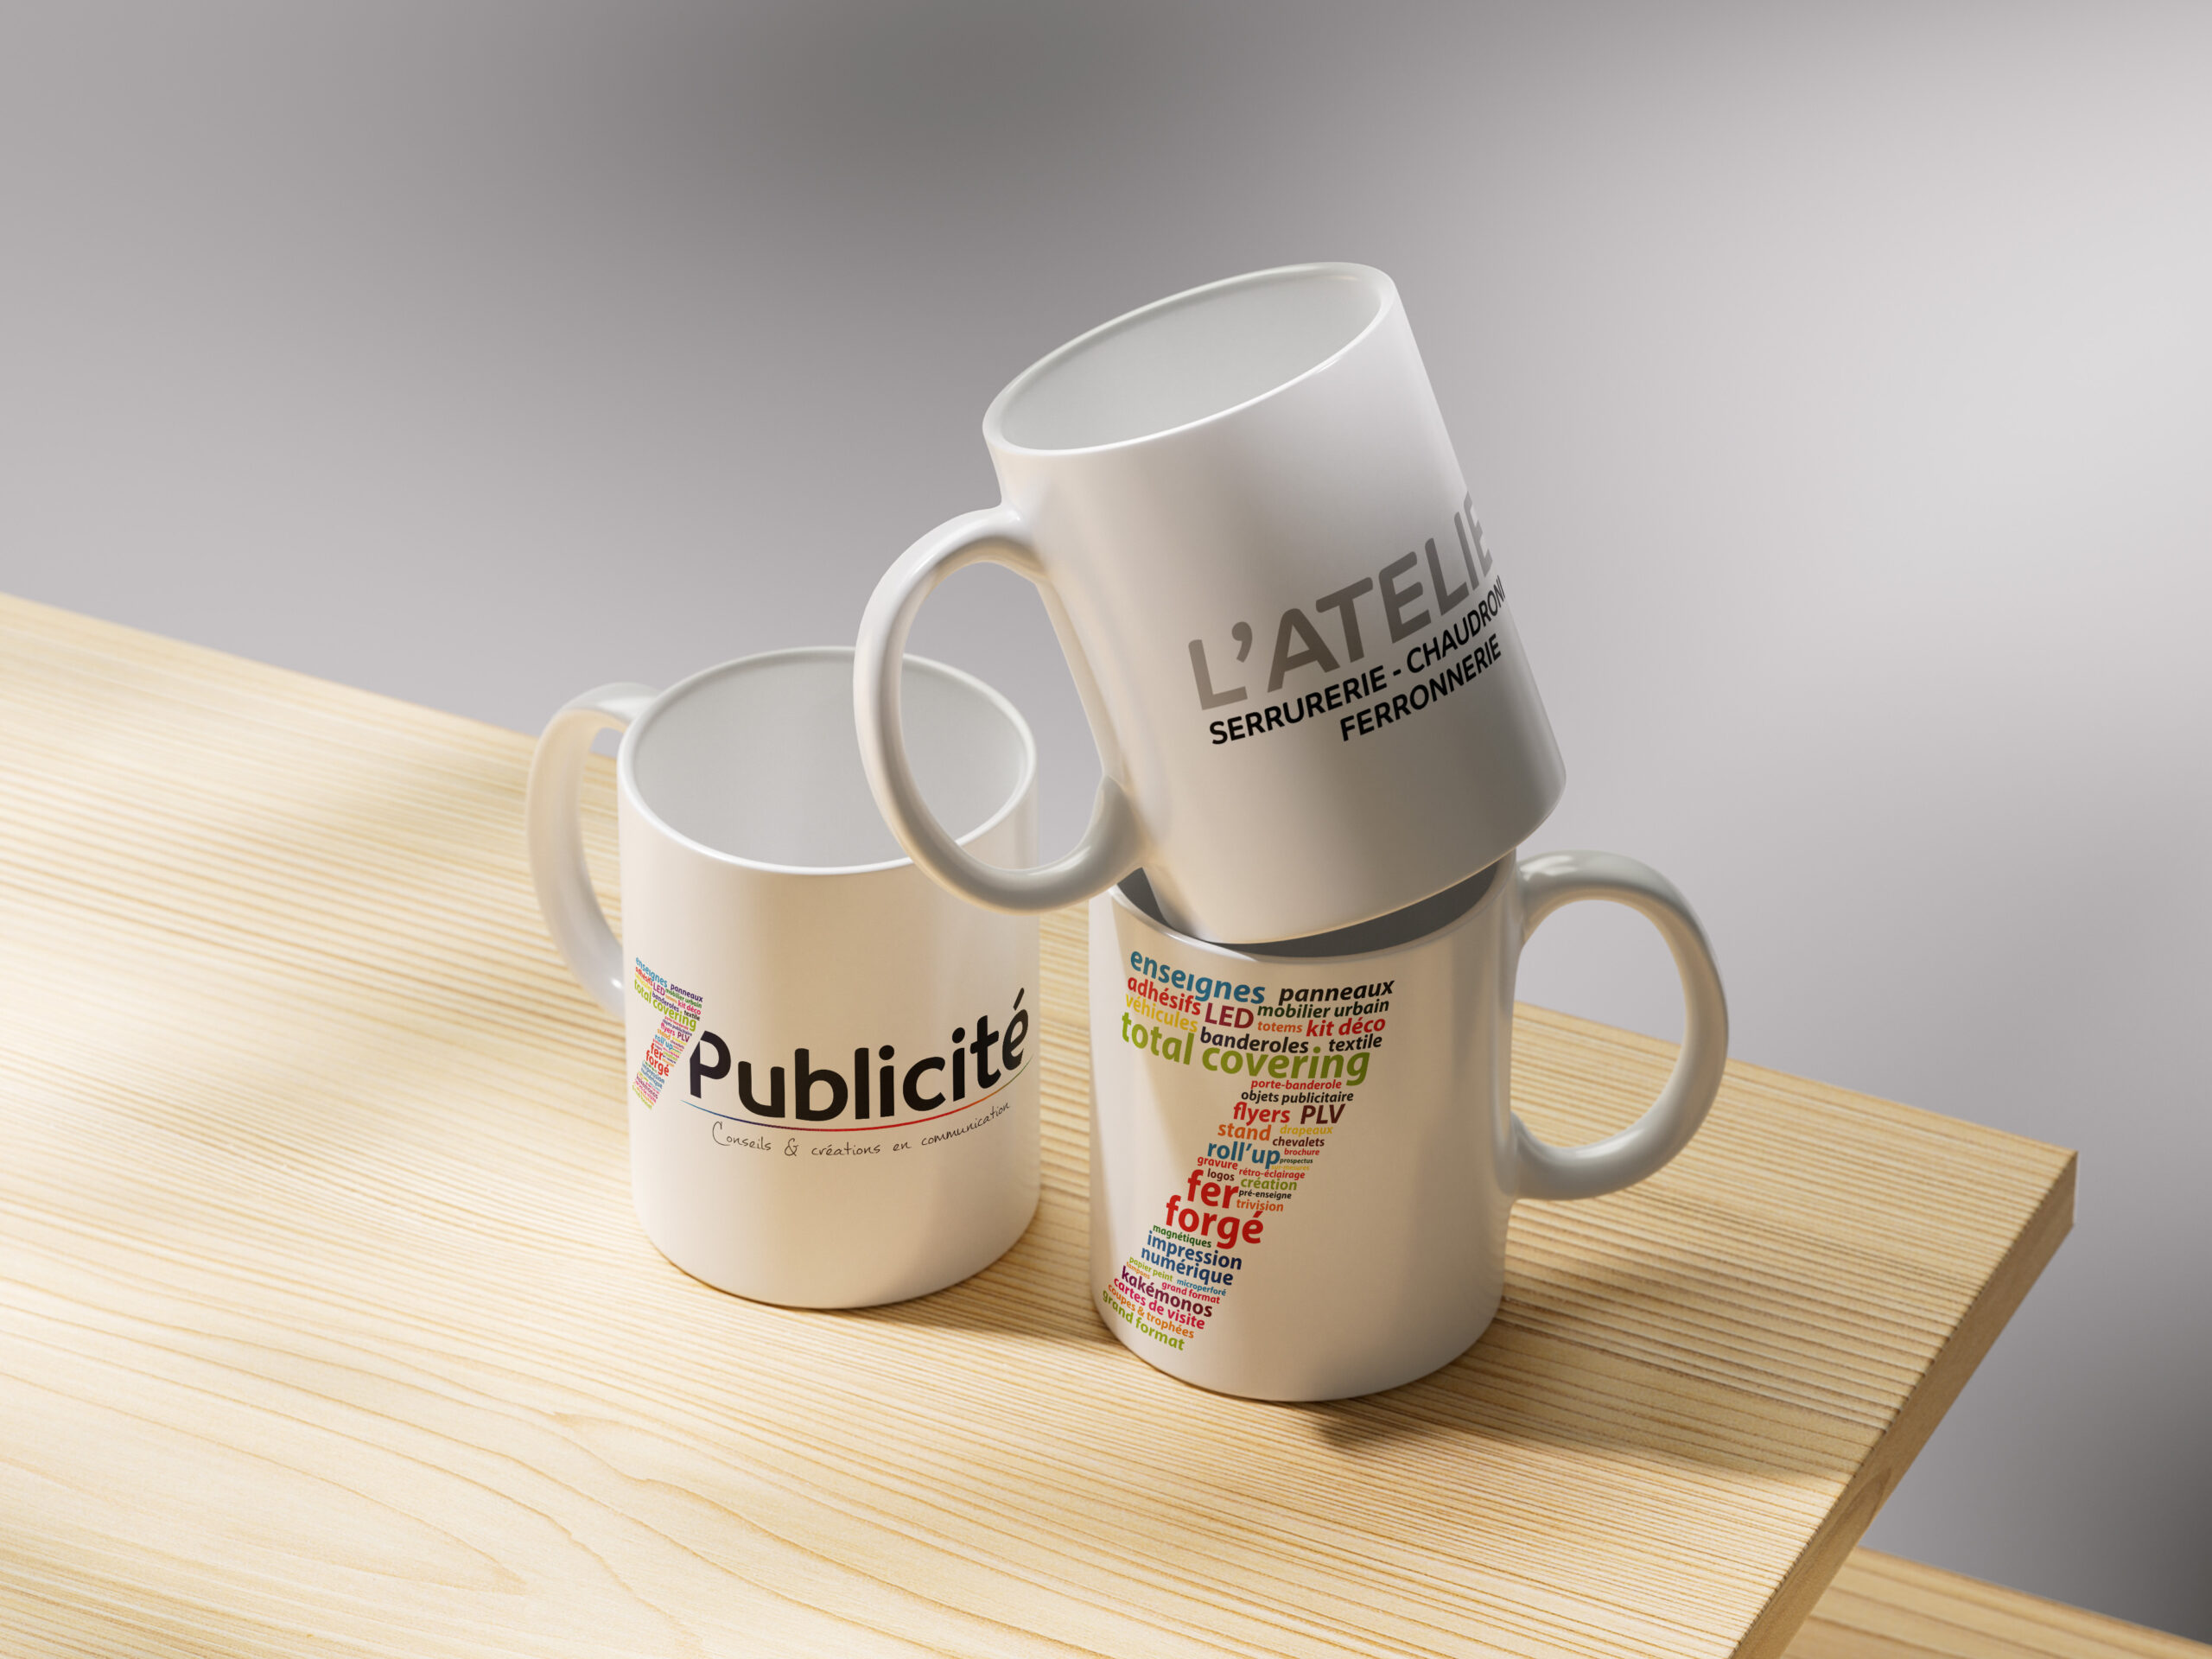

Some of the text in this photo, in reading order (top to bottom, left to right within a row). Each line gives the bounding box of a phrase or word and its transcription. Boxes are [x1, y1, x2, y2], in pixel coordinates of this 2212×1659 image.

[1188, 491, 1493, 711] L'ATELIE
[1339, 633, 1503, 742] FERRONNERIE
[1210, 664, 1388, 745] SERRURERIE
[652, 982, 665, 995] LED
[1130, 950, 1266, 1004] enseignes
[634, 979, 652, 1003] total
[652, 999, 697, 1032] covering
[670, 983, 703, 1003] panneaux
[1127, 976, 1201, 1016] adhésifs
[1278, 980, 1395, 1006] panneaux
[1125, 994, 1198, 1033] véhicules
[1205, 1002, 1255, 1029] LED
[1256, 998, 1389, 1019] mobilier urbain
[677, 1031, 690, 1043] PLV
[1257, 1020, 1303, 1033] totems
[1306, 1016, 1386, 1037] kit déco
[651, 1043, 664, 1060] fer
[1122, 1012, 1370, 1086] total covering
[1199, 1026, 1309, 1053] banderoles
[1328, 1033, 1382, 1052] textile
[645, 1050, 670, 1077] forgé
[690, 988, 1029, 1122] Publicité
[1250, 1079, 1342, 1090] porte-banderole
[1241, 1090, 1354, 1105] objets publicitaire
[1233, 1101, 1291, 1127] flyers
[1300, 1103, 1346, 1125] PLV
[712, 1102, 1010, 1157] Conseils & créations en communication
[1217, 1122, 1272, 1141] stand
[1272, 1136, 1325, 1147] chevalets
[1280, 1124, 1334, 1137] drapeaux
[1197, 1156, 1238, 1171] gravure
[1207, 1141, 1281, 1170] roll'up
[1284, 1147, 1320, 1156] brochure
[1206, 1168, 1236, 1182] logos
[1238, 1167, 1306, 1181] rétro-éclairage
[1240, 1176, 1298, 1191] création
[1187, 1168, 1240, 1209] fer
[1238, 1188, 1292, 1201] pré-enseigne
[1236, 1198, 1285, 1211] trivision
[1166, 1194, 1264, 1249] forgé
[1152, 1224, 1212, 1248] magnétiques
[1147, 1230, 1243, 1270] impression
[1126, 1262, 1151, 1280] tampons
[1128, 1256, 1173, 1282] papier peint
[1141, 1247, 1234, 1286] numérique
[1121, 1265, 1213, 1318] kakémonos
[1161, 1281, 1221, 1305] grand format
[1176, 1278, 1227, 1296] microperforé
[1108, 1283, 1195, 1338] coupes & trophées
[1113, 1278, 1205, 1330] cartes de visite
[1103, 1290, 1185, 1351] grand format
